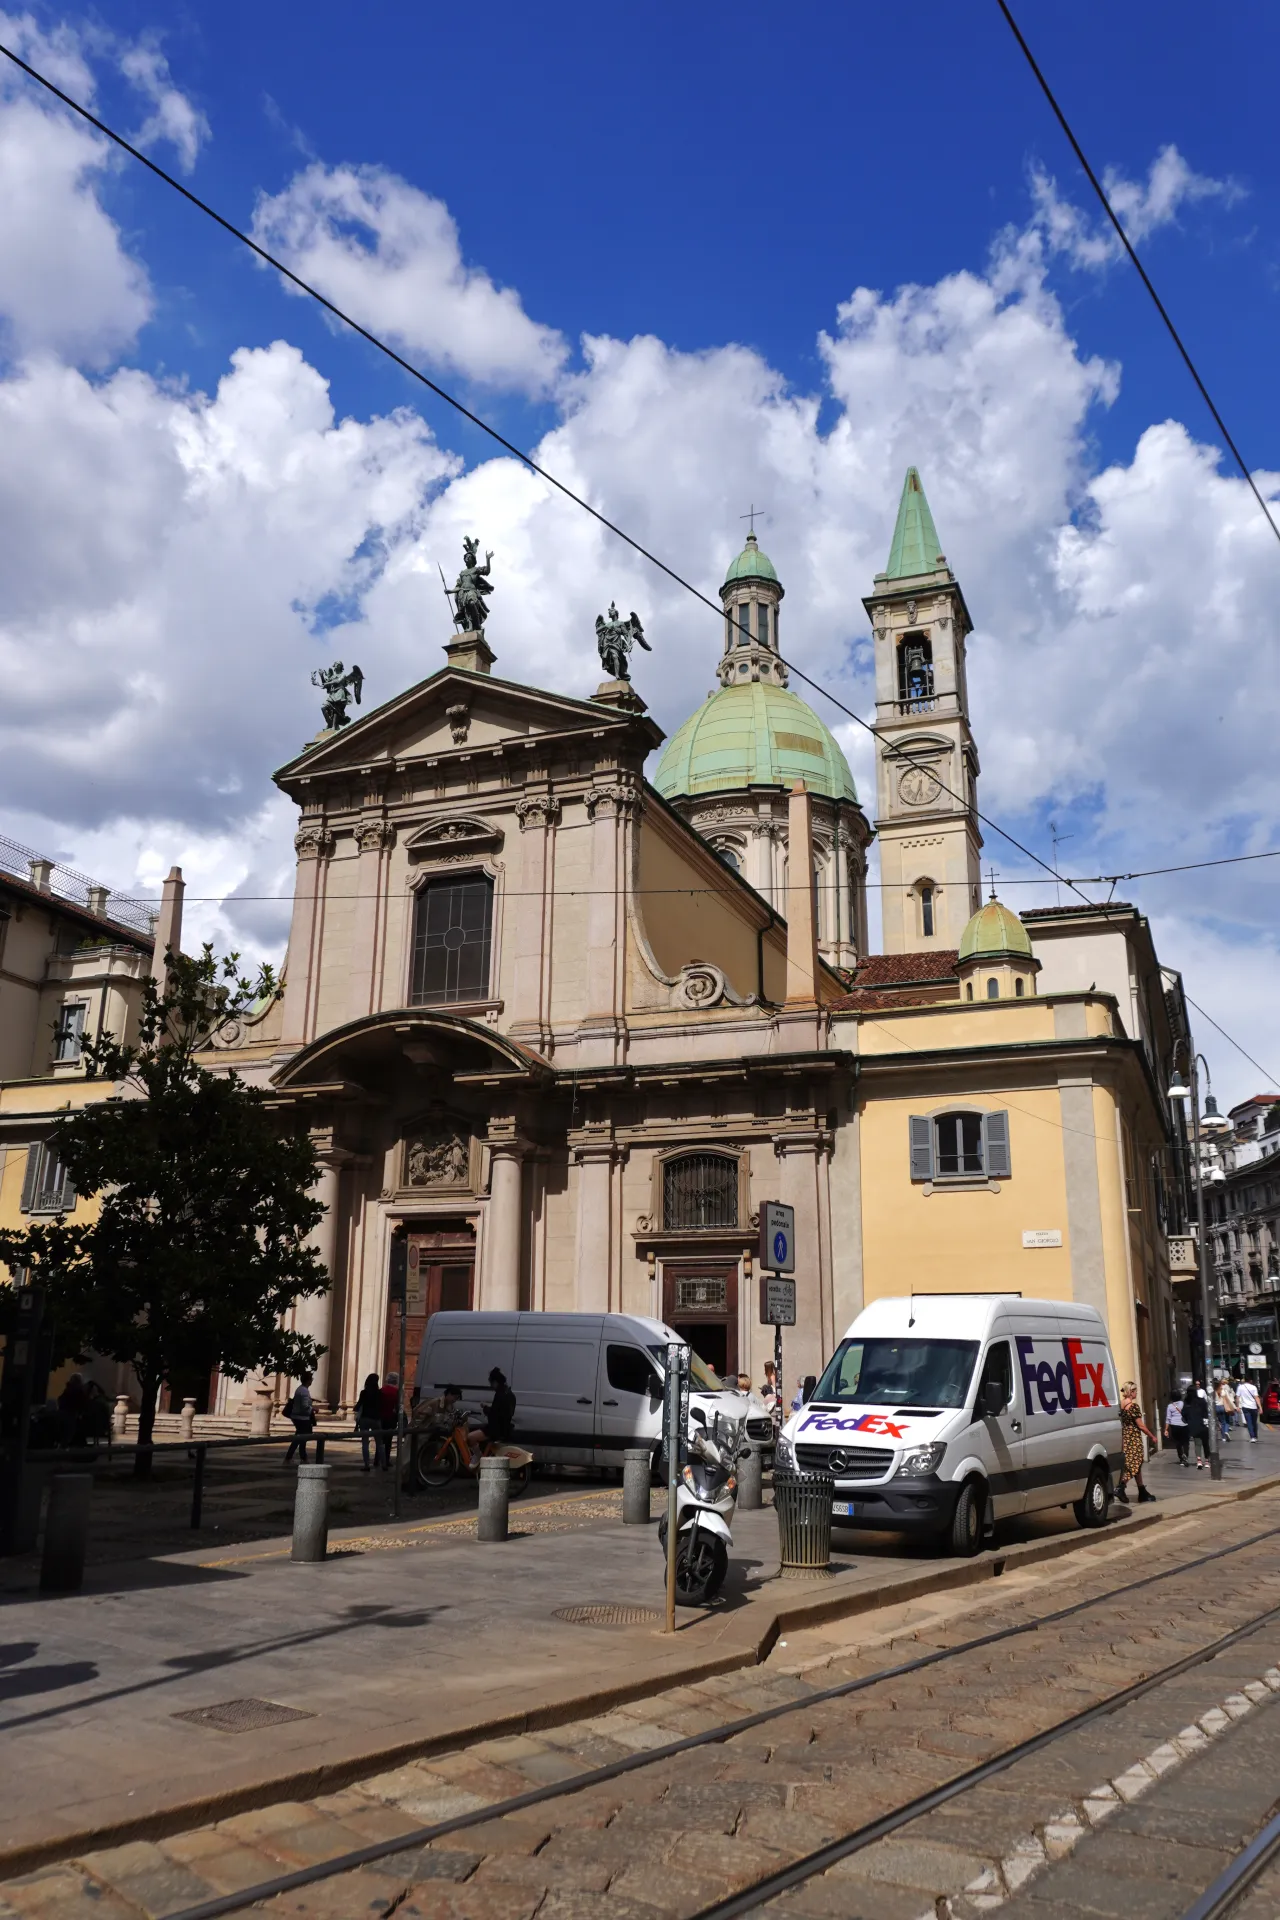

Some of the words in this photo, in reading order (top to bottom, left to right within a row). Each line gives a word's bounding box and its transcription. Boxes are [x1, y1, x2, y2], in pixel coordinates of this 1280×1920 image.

[771, 1219, 790, 1229] pedonale
[1015, 1336, 1112, 1415] FedEx
[797, 1414, 911, 1439] FedEx
